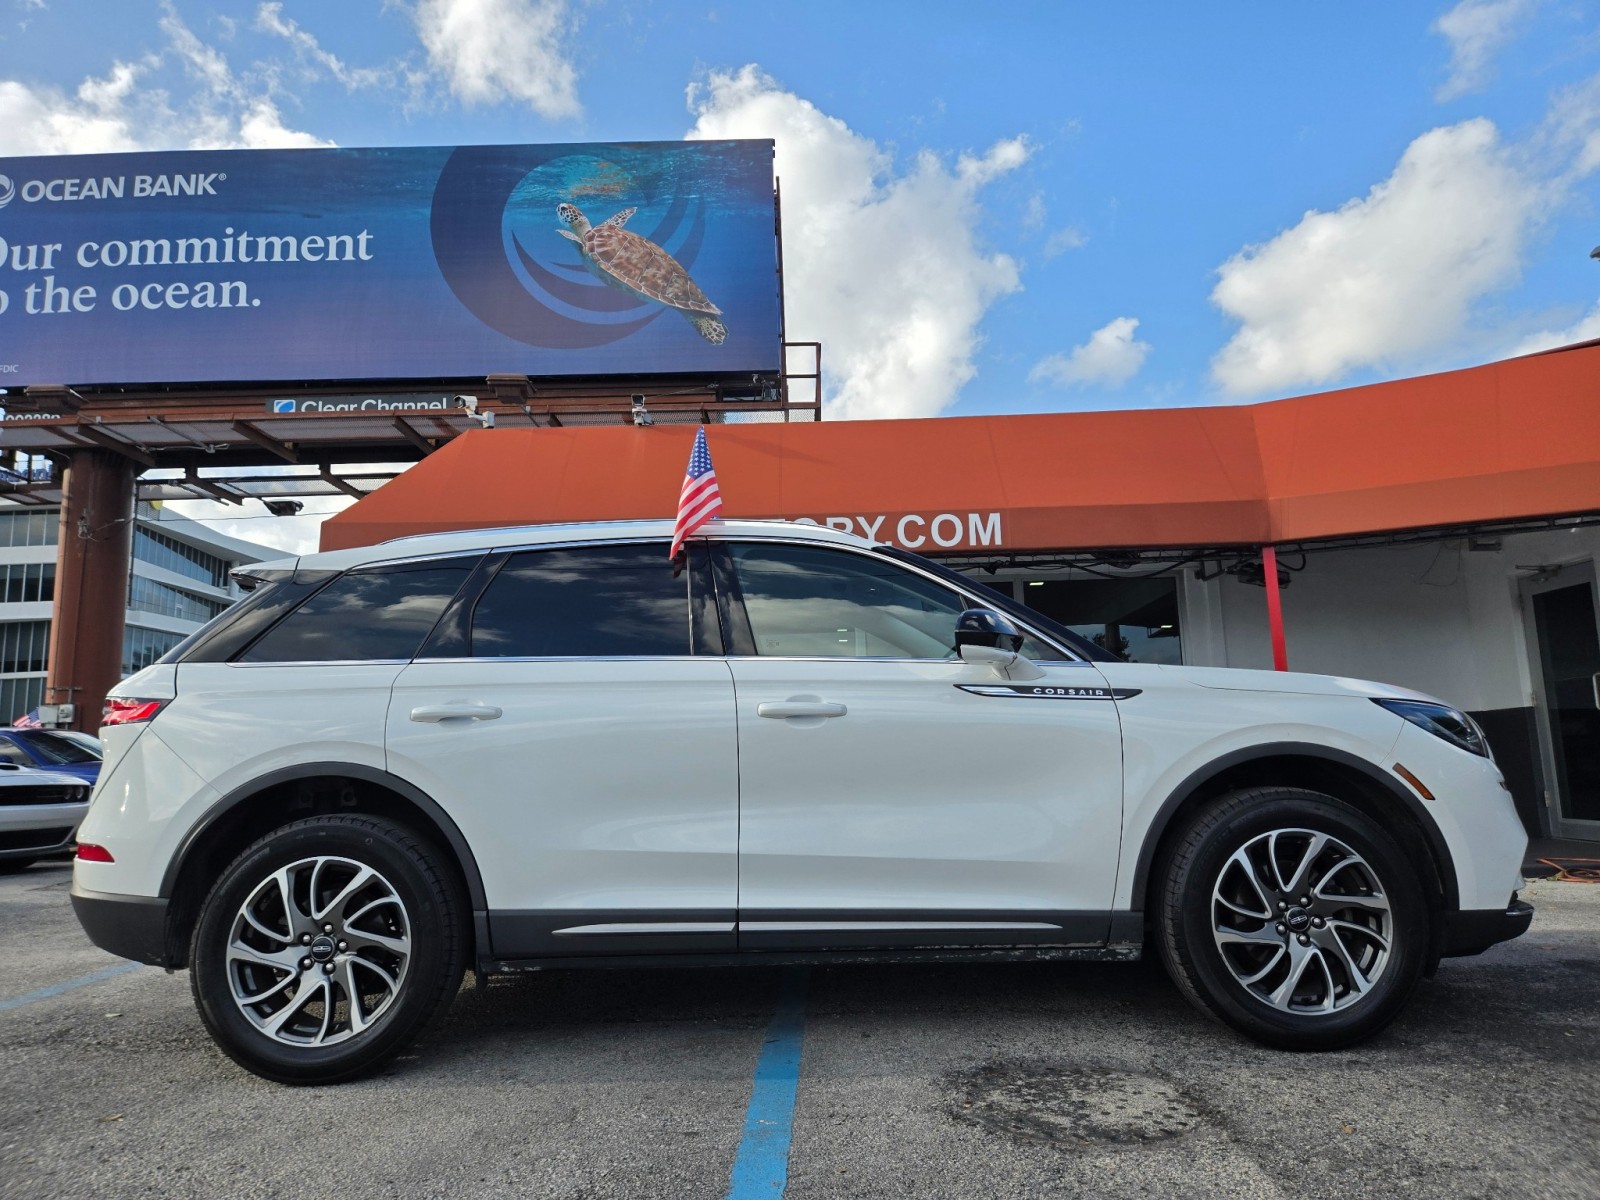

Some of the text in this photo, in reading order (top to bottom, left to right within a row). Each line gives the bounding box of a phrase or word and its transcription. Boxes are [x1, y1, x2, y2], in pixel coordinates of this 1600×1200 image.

[21, 177, 125, 202] OCEAN
[0, 226, 374, 271] ur commitment
[25, 275, 97, 315] the
[111, 278, 261, 311] ocean.
[1033, 687, 1104, 696] CORSAIR
